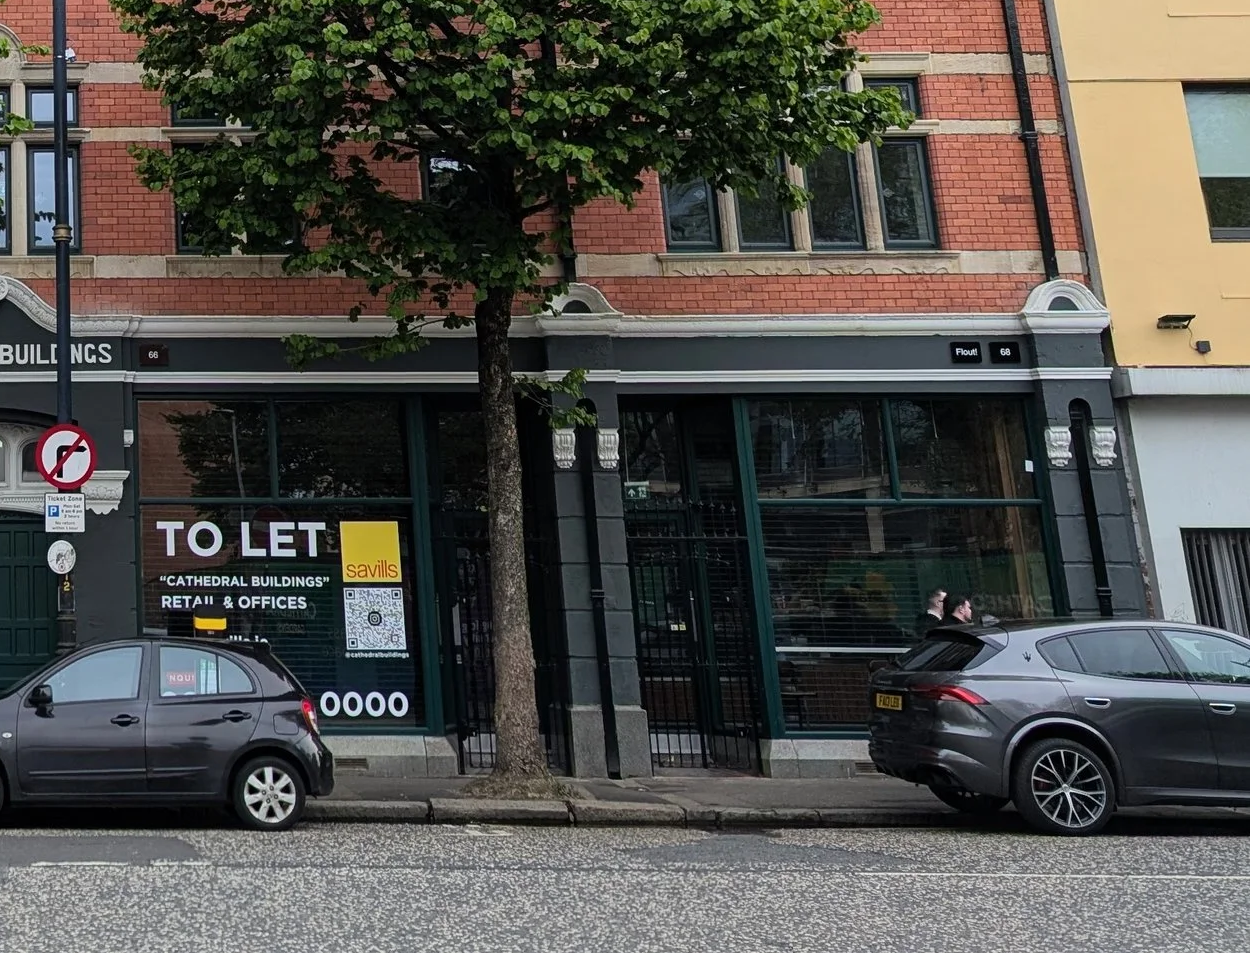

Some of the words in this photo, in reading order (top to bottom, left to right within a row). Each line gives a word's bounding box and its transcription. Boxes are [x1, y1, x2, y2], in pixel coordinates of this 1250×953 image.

[0, 343, 112, 365] BUILNGS
[148, 350, 158, 359] 66
[999, 347, 1011, 356] 68
[50, 506, 58, 516] P
[156, 520, 223, 557] TO
[241, 521, 326, 557] LET
[346, 559, 399, 579] savills
[63, 581, 71, 592] 2
[223, 595, 234, 610] &
[238, 595, 308, 609] OFFICES
[345, 651, 410, 659] @cathedralbuildings
[320, 691, 409, 718] 0000
